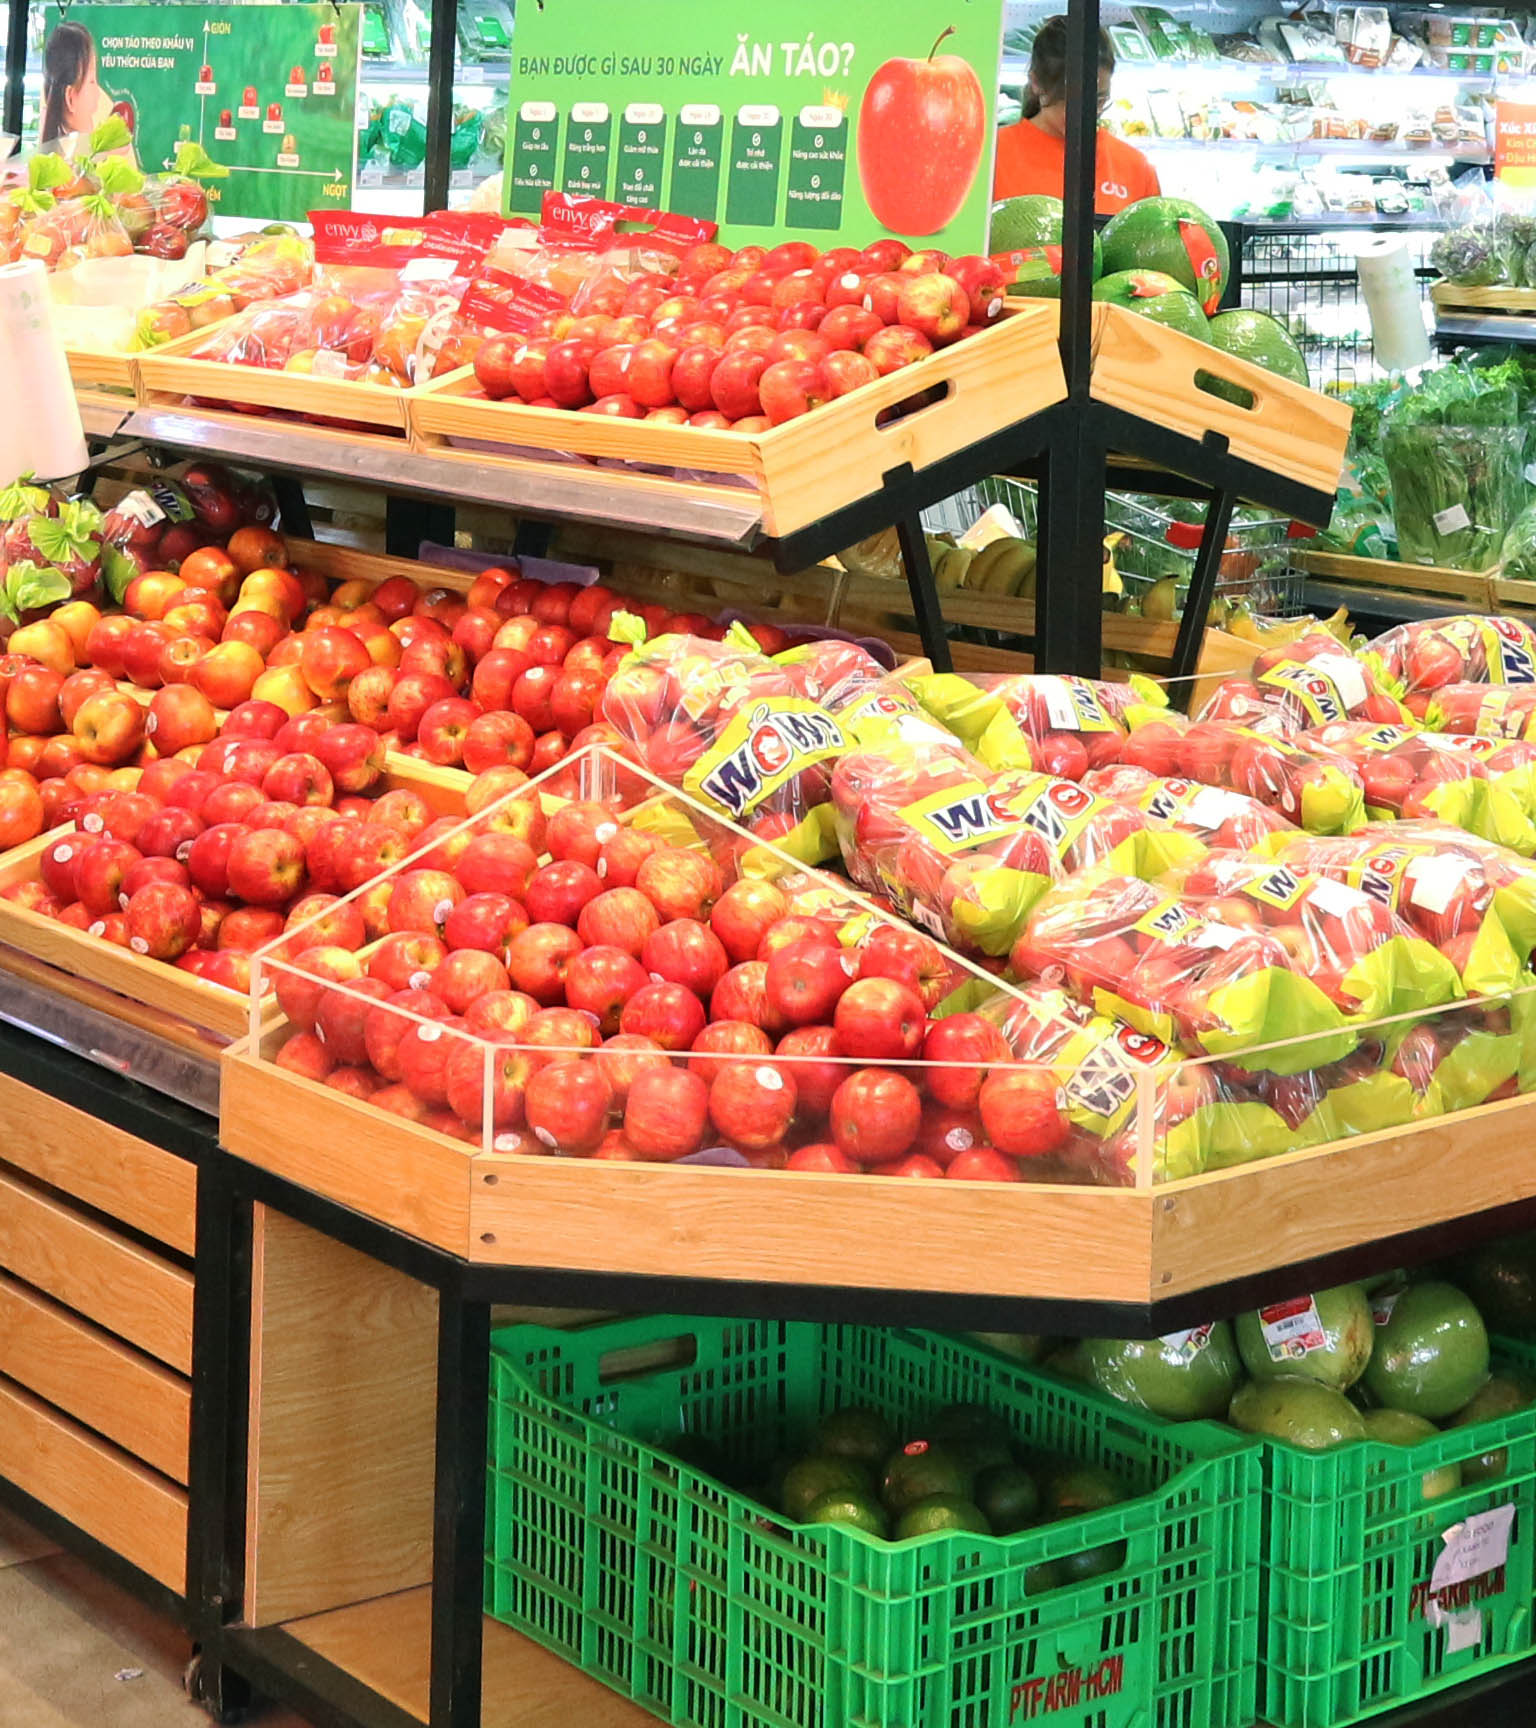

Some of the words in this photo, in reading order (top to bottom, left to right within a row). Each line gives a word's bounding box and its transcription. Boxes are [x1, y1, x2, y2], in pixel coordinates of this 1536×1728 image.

[519, 57, 550, 80] BẠN
[554, 54, 596, 80] ĐƯỢC
[601, 51, 616, 76] GÌ
[621, 57, 652, 76] SAU
[657, 57, 674, 76] 30
[679, 51, 724, 76] NGÀY
[729, 33, 772, 77] ĂN
[780, 32, 855, 77] TÁO?
[322, 184, 347, 200] NGỌT
[552, 207, 589, 233] envy
[325, 223, 360, 248] envy
[701, 704, 846, 817] WOW!
